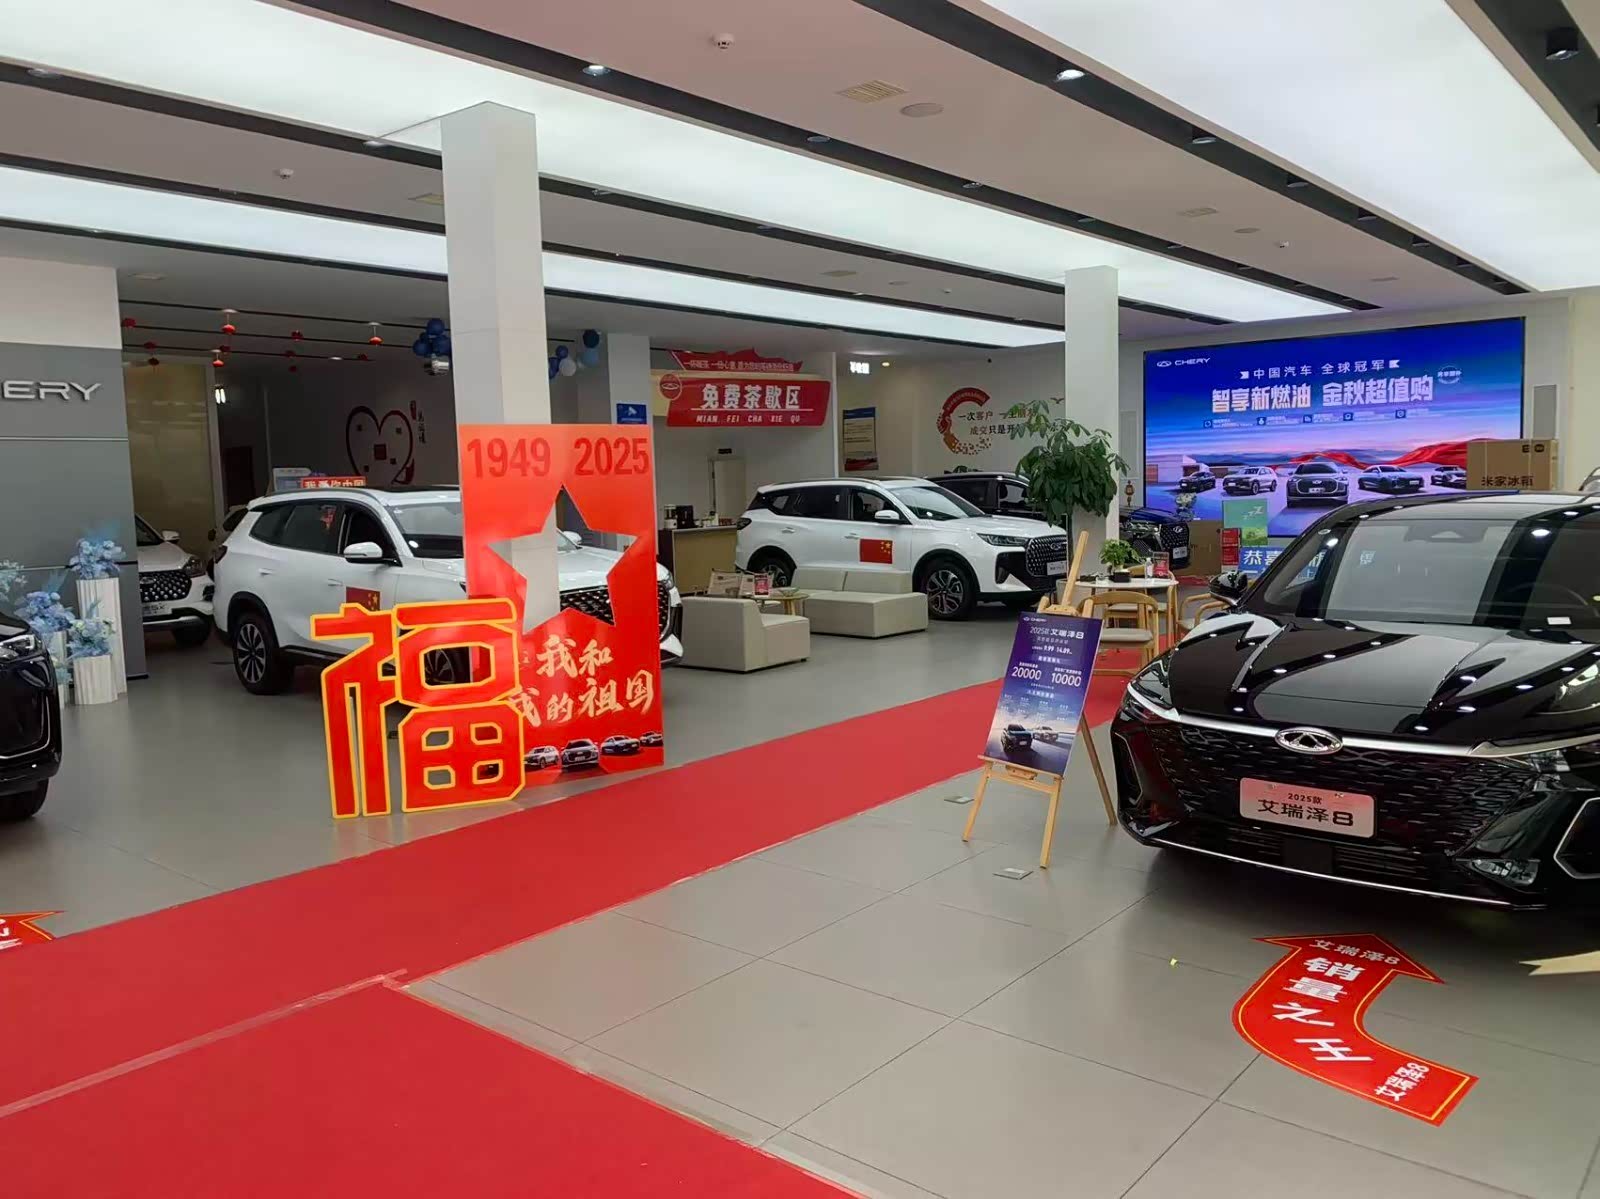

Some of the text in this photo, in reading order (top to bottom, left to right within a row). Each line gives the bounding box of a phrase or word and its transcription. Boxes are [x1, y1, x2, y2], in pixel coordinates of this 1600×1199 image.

[1174, 357, 1211, 366] CHERY
[1253, 359, 1385, 380] 中国汽车 全球冠军
[3, 380, 101, 401] ERY
[701, 383, 801, 410] 免费茶歇区
[1211, 374, 1434, 414] 智享新燃油 金秋超值购
[696, 414, 801, 423] MIAN FEI CHA XIE QU
[467, 437, 650, 478] 1949 2025
[1481, 476, 1534, 487] 米家冰箱
[536, 634, 614, 678] 我和
[1011, 666, 1042, 681] 20000
[1051, 672, 1082, 687] 10000
[311, 597, 526, 819] 福
[508, 669, 655, 728] 我的祖国
[1287, 793, 1322, 804] 2025款
[1258, 799, 1353, 827] 艾瑞泽8
[1309, 939, 1401, 966] 艾瑞泽8
[1272, 957, 1374, 1062] 销量之王
[1374, 1062, 1430, 1102] 艾瑞泽8
